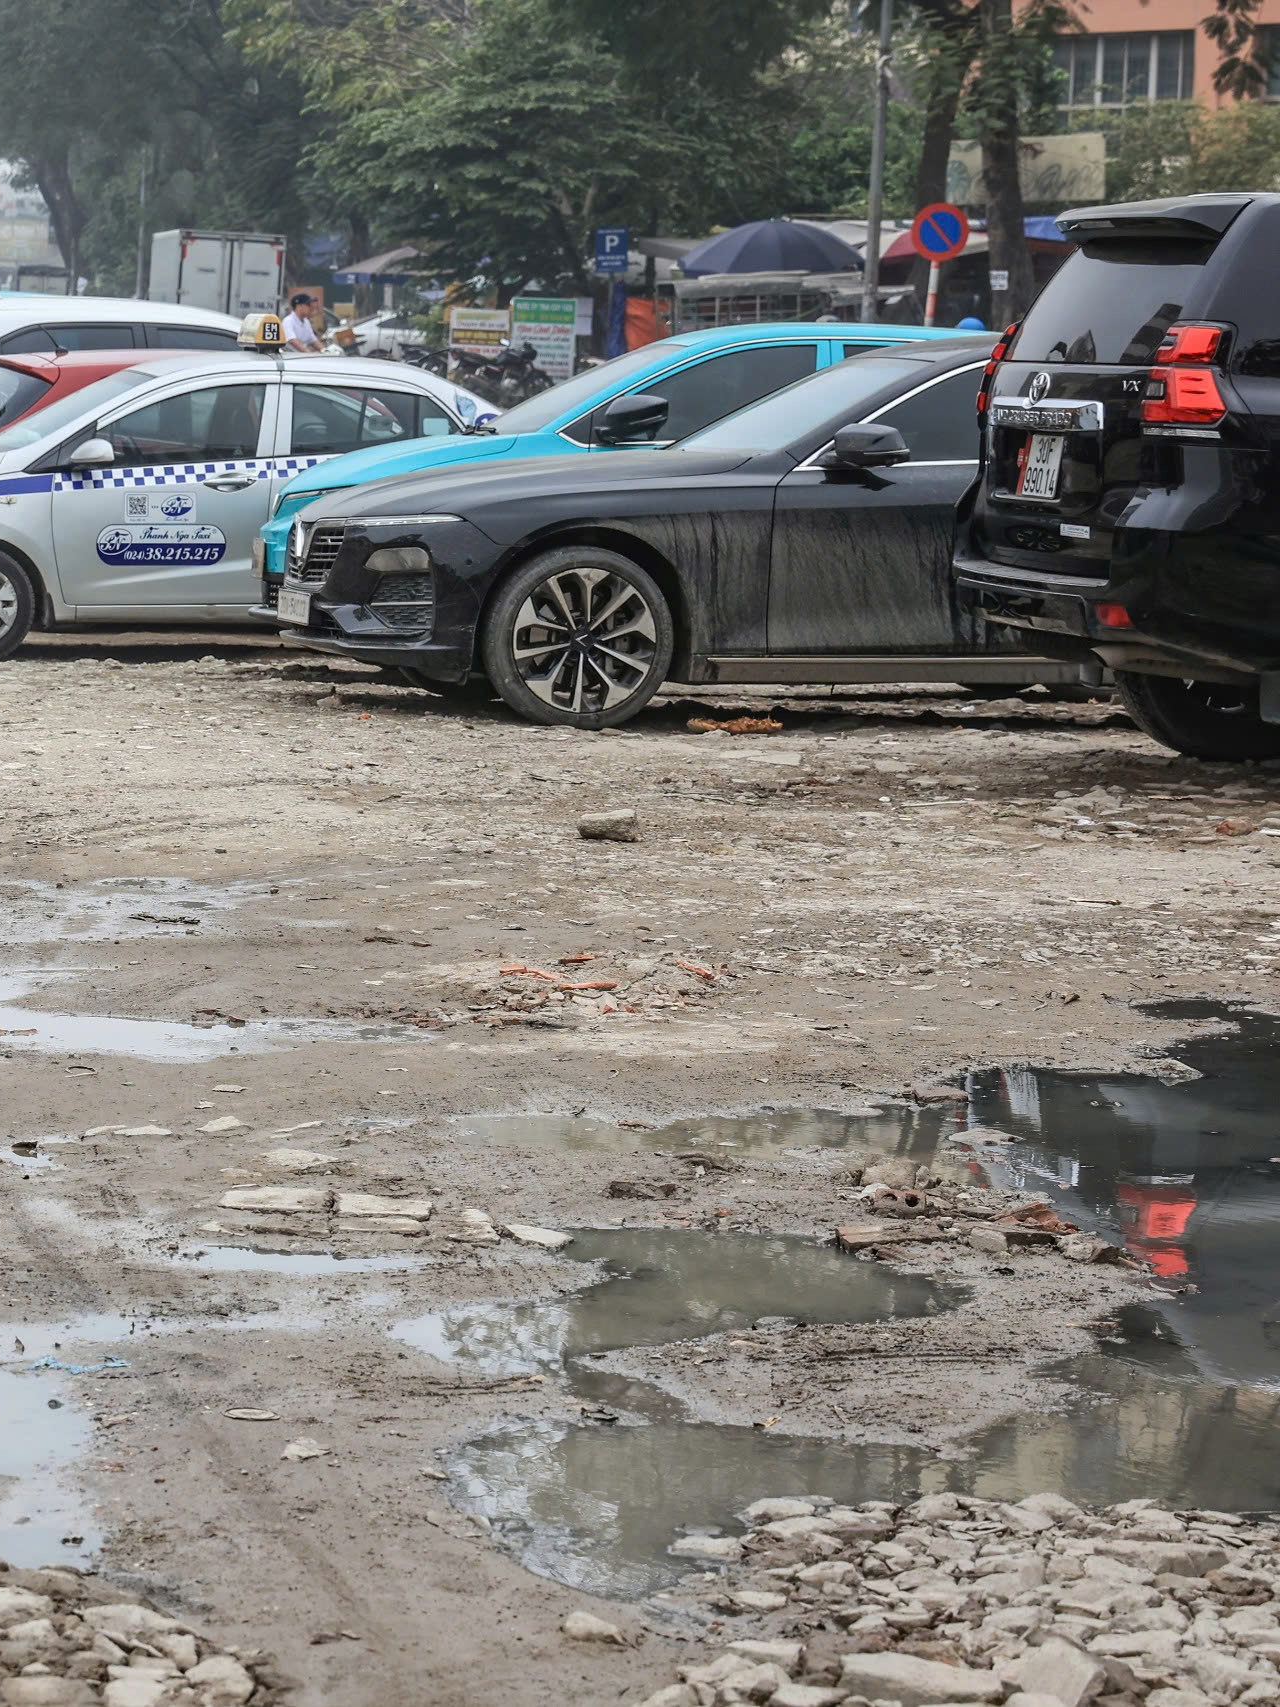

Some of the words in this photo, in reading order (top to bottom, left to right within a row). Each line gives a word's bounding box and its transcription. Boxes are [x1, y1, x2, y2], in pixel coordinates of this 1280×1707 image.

[606, 235, 619, 252] P
[264, 332, 277, 340] DI
[265, 323, 278, 332] EM
[1122, 380, 1141, 392] VX
[1036, 437, 1056, 465] 30F
[1023, 467, 1056, 495] 990.14
[139, 526, 169, 540] Thanh
[170, 530, 189, 543] Nga
[190, 526, 212, 540] Taxi
